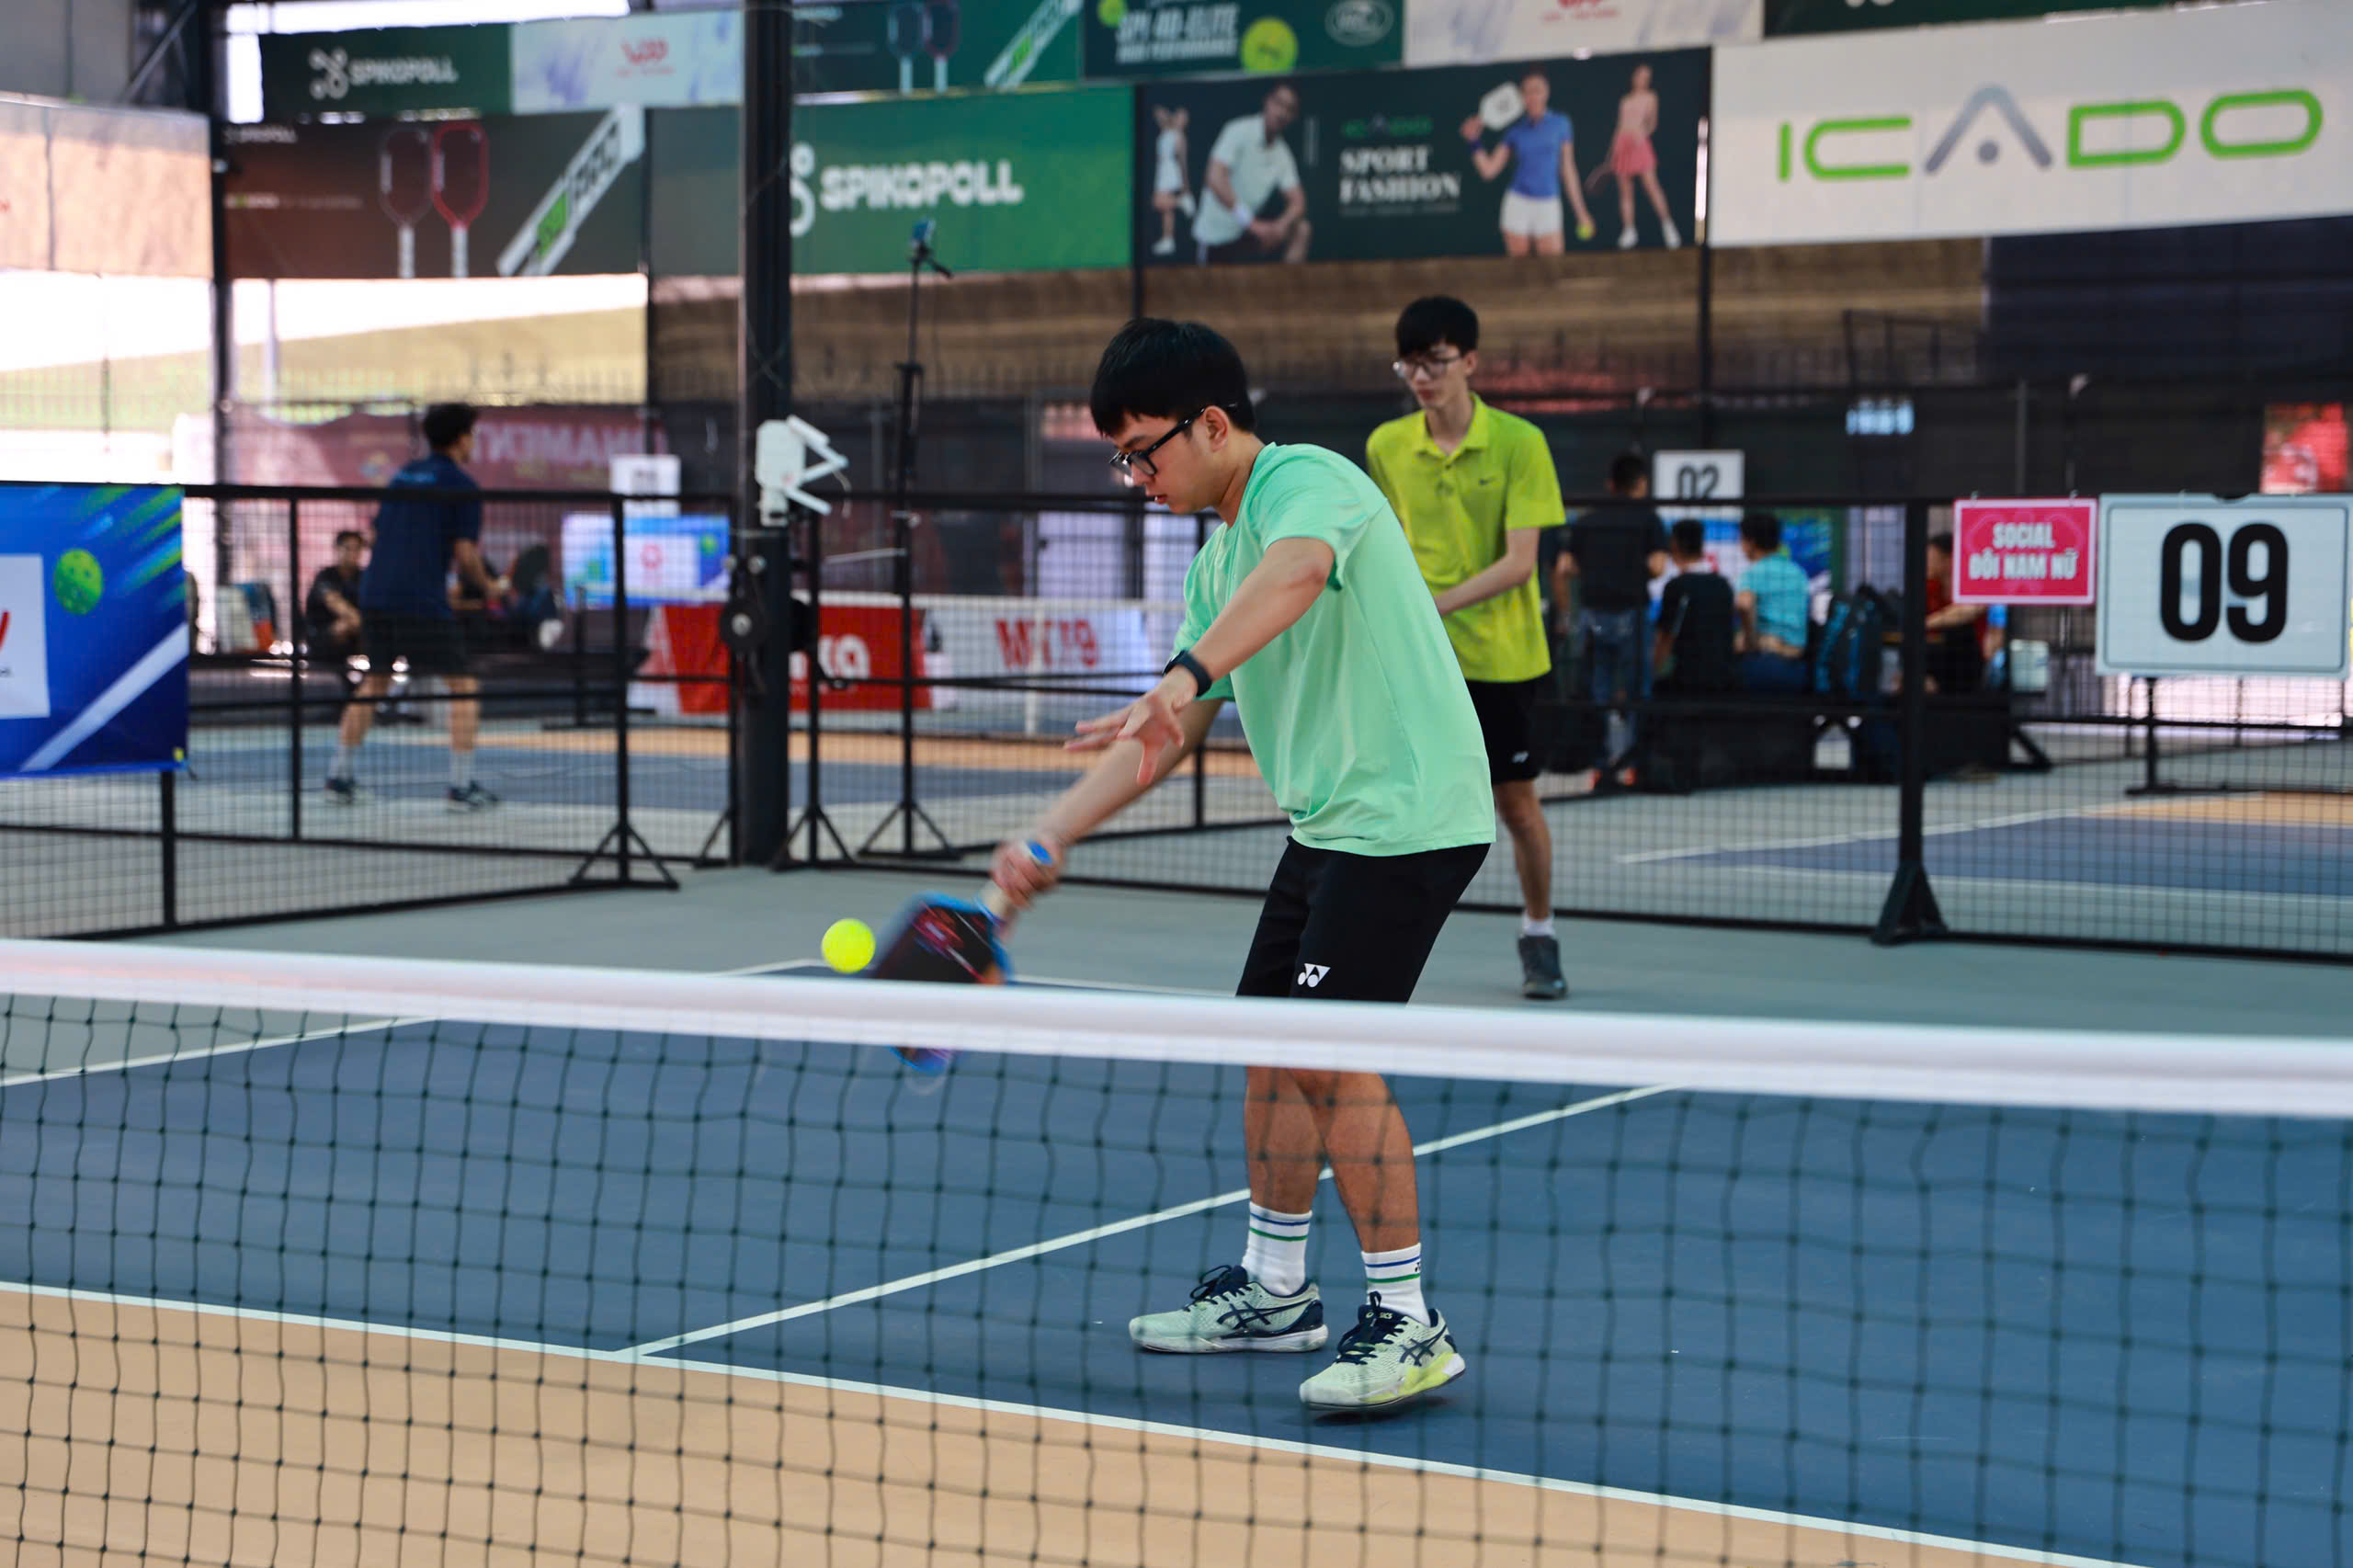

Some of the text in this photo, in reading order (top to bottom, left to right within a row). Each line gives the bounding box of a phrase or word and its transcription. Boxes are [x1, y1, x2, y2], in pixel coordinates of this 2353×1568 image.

[1779, 84, 2323, 181] ICADO
[1340, 145, 1431, 173] SPORT
[820, 160, 1024, 210] SPIKOPOLL
[1340, 173, 1461, 203] FASHION
[1993, 522, 2055, 549] SOCIAL
[2004, 552, 2047, 579] NAM
[2161, 523, 2288, 642] 09
